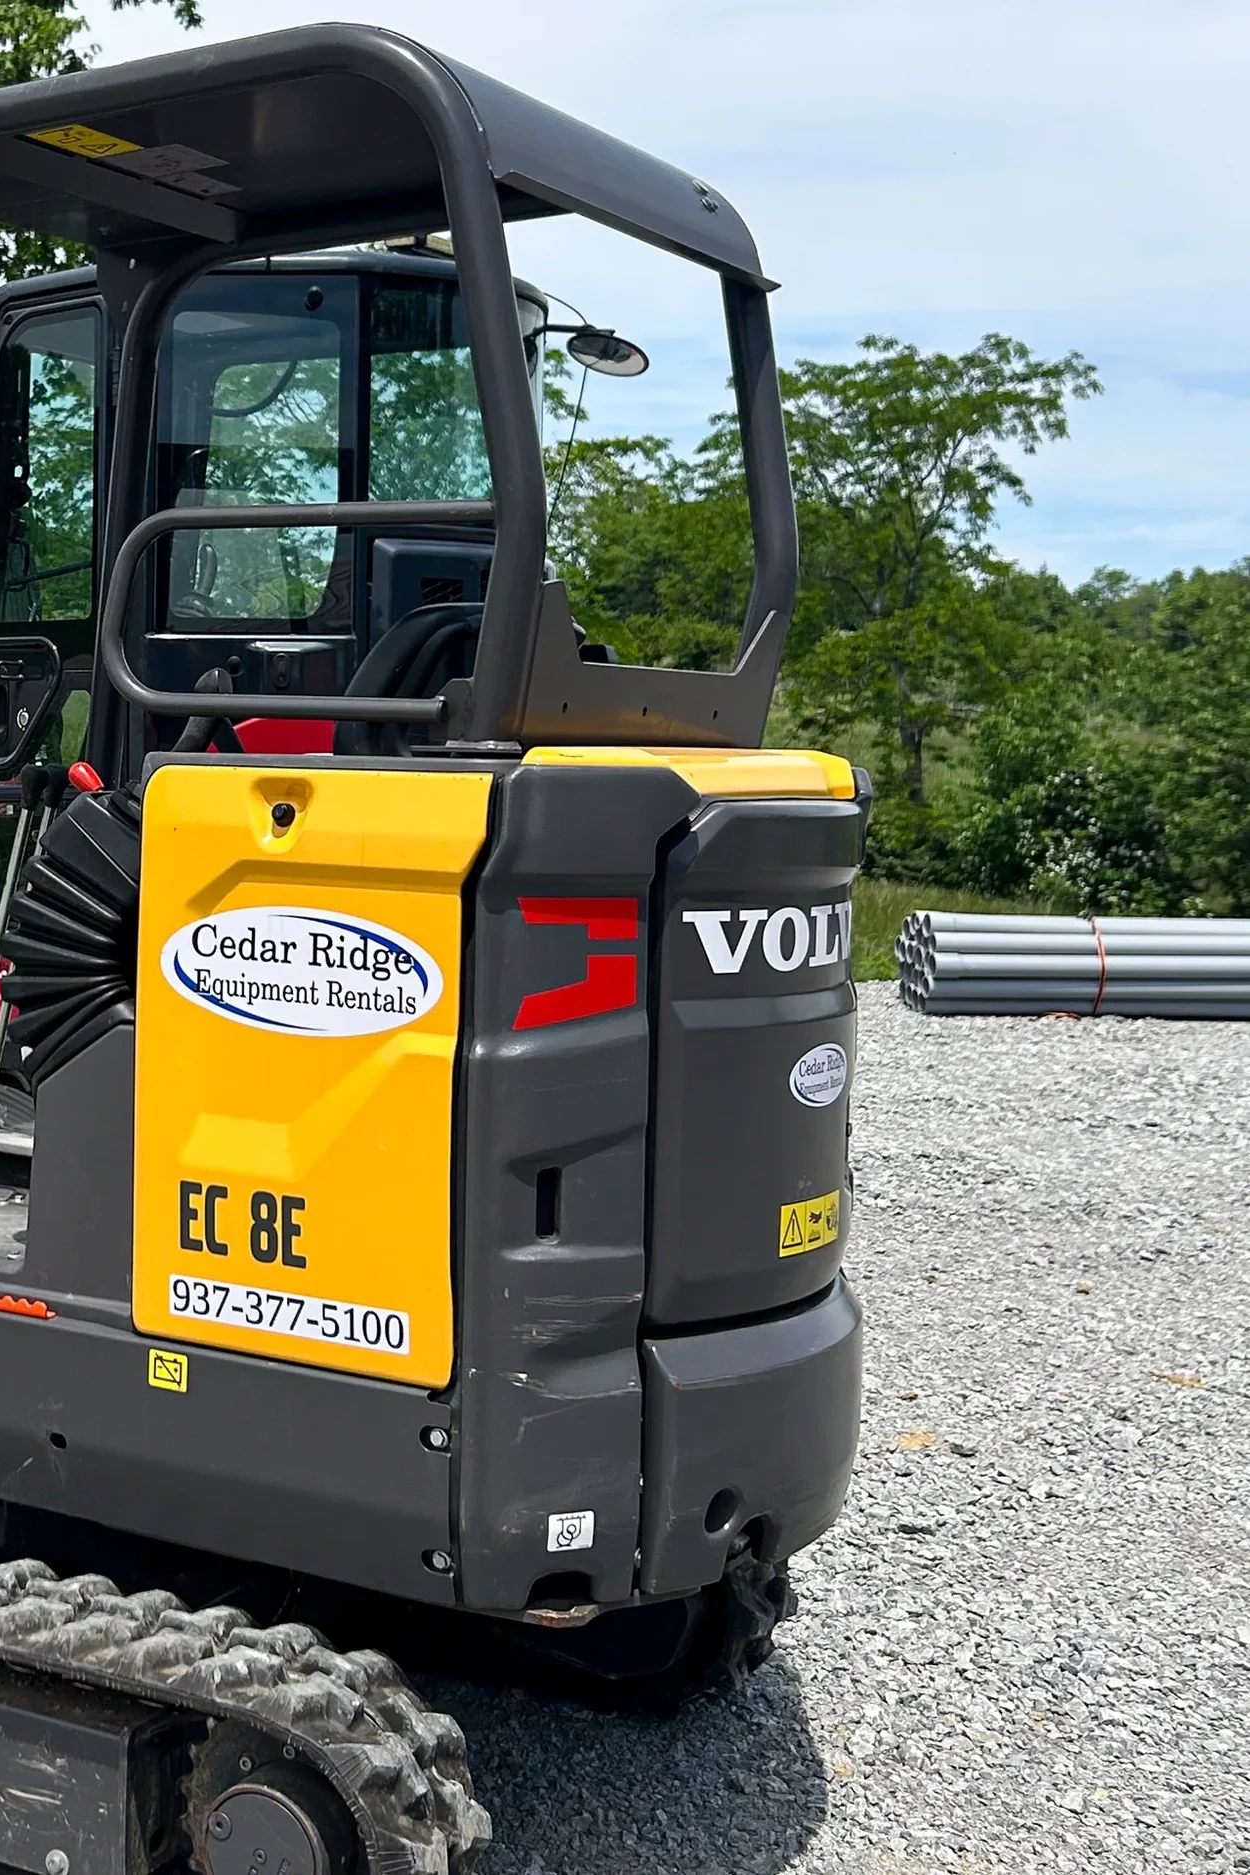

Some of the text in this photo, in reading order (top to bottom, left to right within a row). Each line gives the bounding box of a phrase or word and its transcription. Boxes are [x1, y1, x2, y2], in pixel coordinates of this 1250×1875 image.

[191, 923, 413, 981] Cedar Ridge
[194, 968, 417, 1015] Equipment Rentals
[799, 1057, 826, 1078] Cedar
[179, 1179, 307, 1269] EC 8E
[172, 1278, 405, 1350] 937-377-5100
